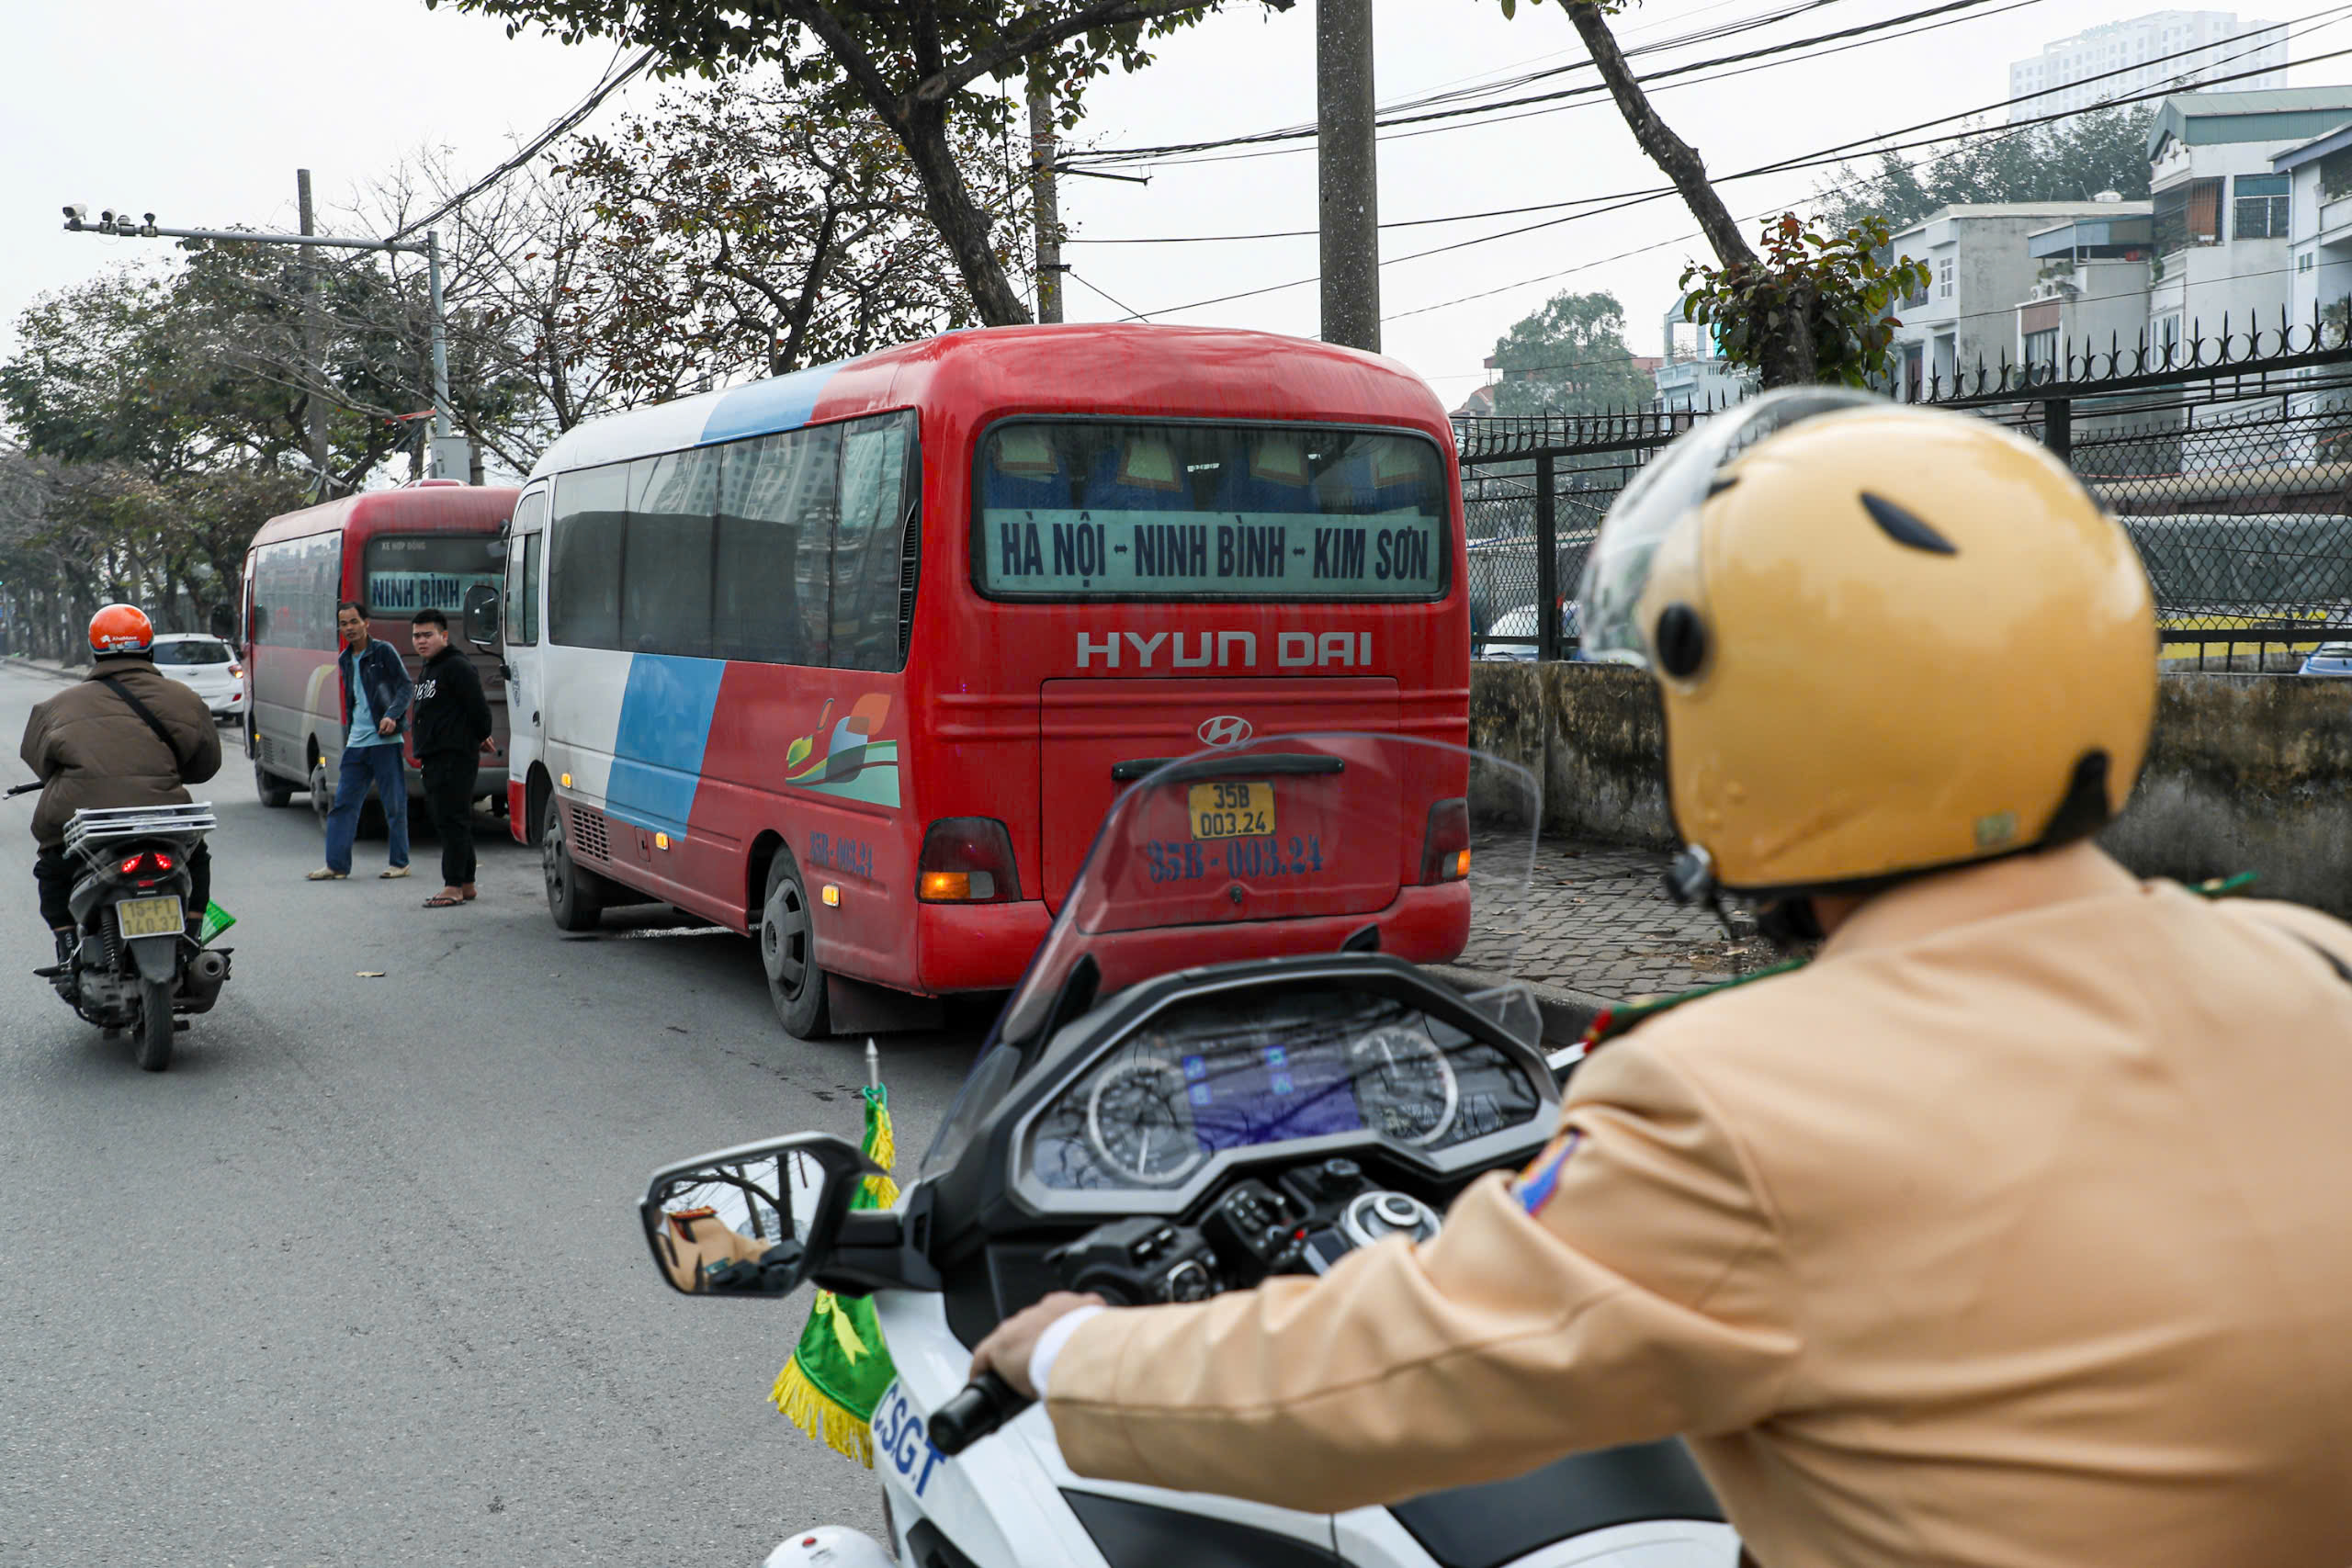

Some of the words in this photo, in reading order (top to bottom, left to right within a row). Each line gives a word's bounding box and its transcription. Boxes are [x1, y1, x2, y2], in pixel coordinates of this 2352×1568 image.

[1001, 511, 1044, 577] HÀ
[1054, 511, 1105, 588] NỘI
[1135, 524, 1208, 577] NINH
[1217, 515, 1285, 578] BÌNH
[1313, 527, 1366, 580] KIM
[1375, 525, 1429, 581] SƠN
[372, 578, 413, 607] NINH
[420, 572, 460, 608] BÌNH
[1213, 784, 1250, 809] 35B
[1200, 810, 1267, 836] 003.24
